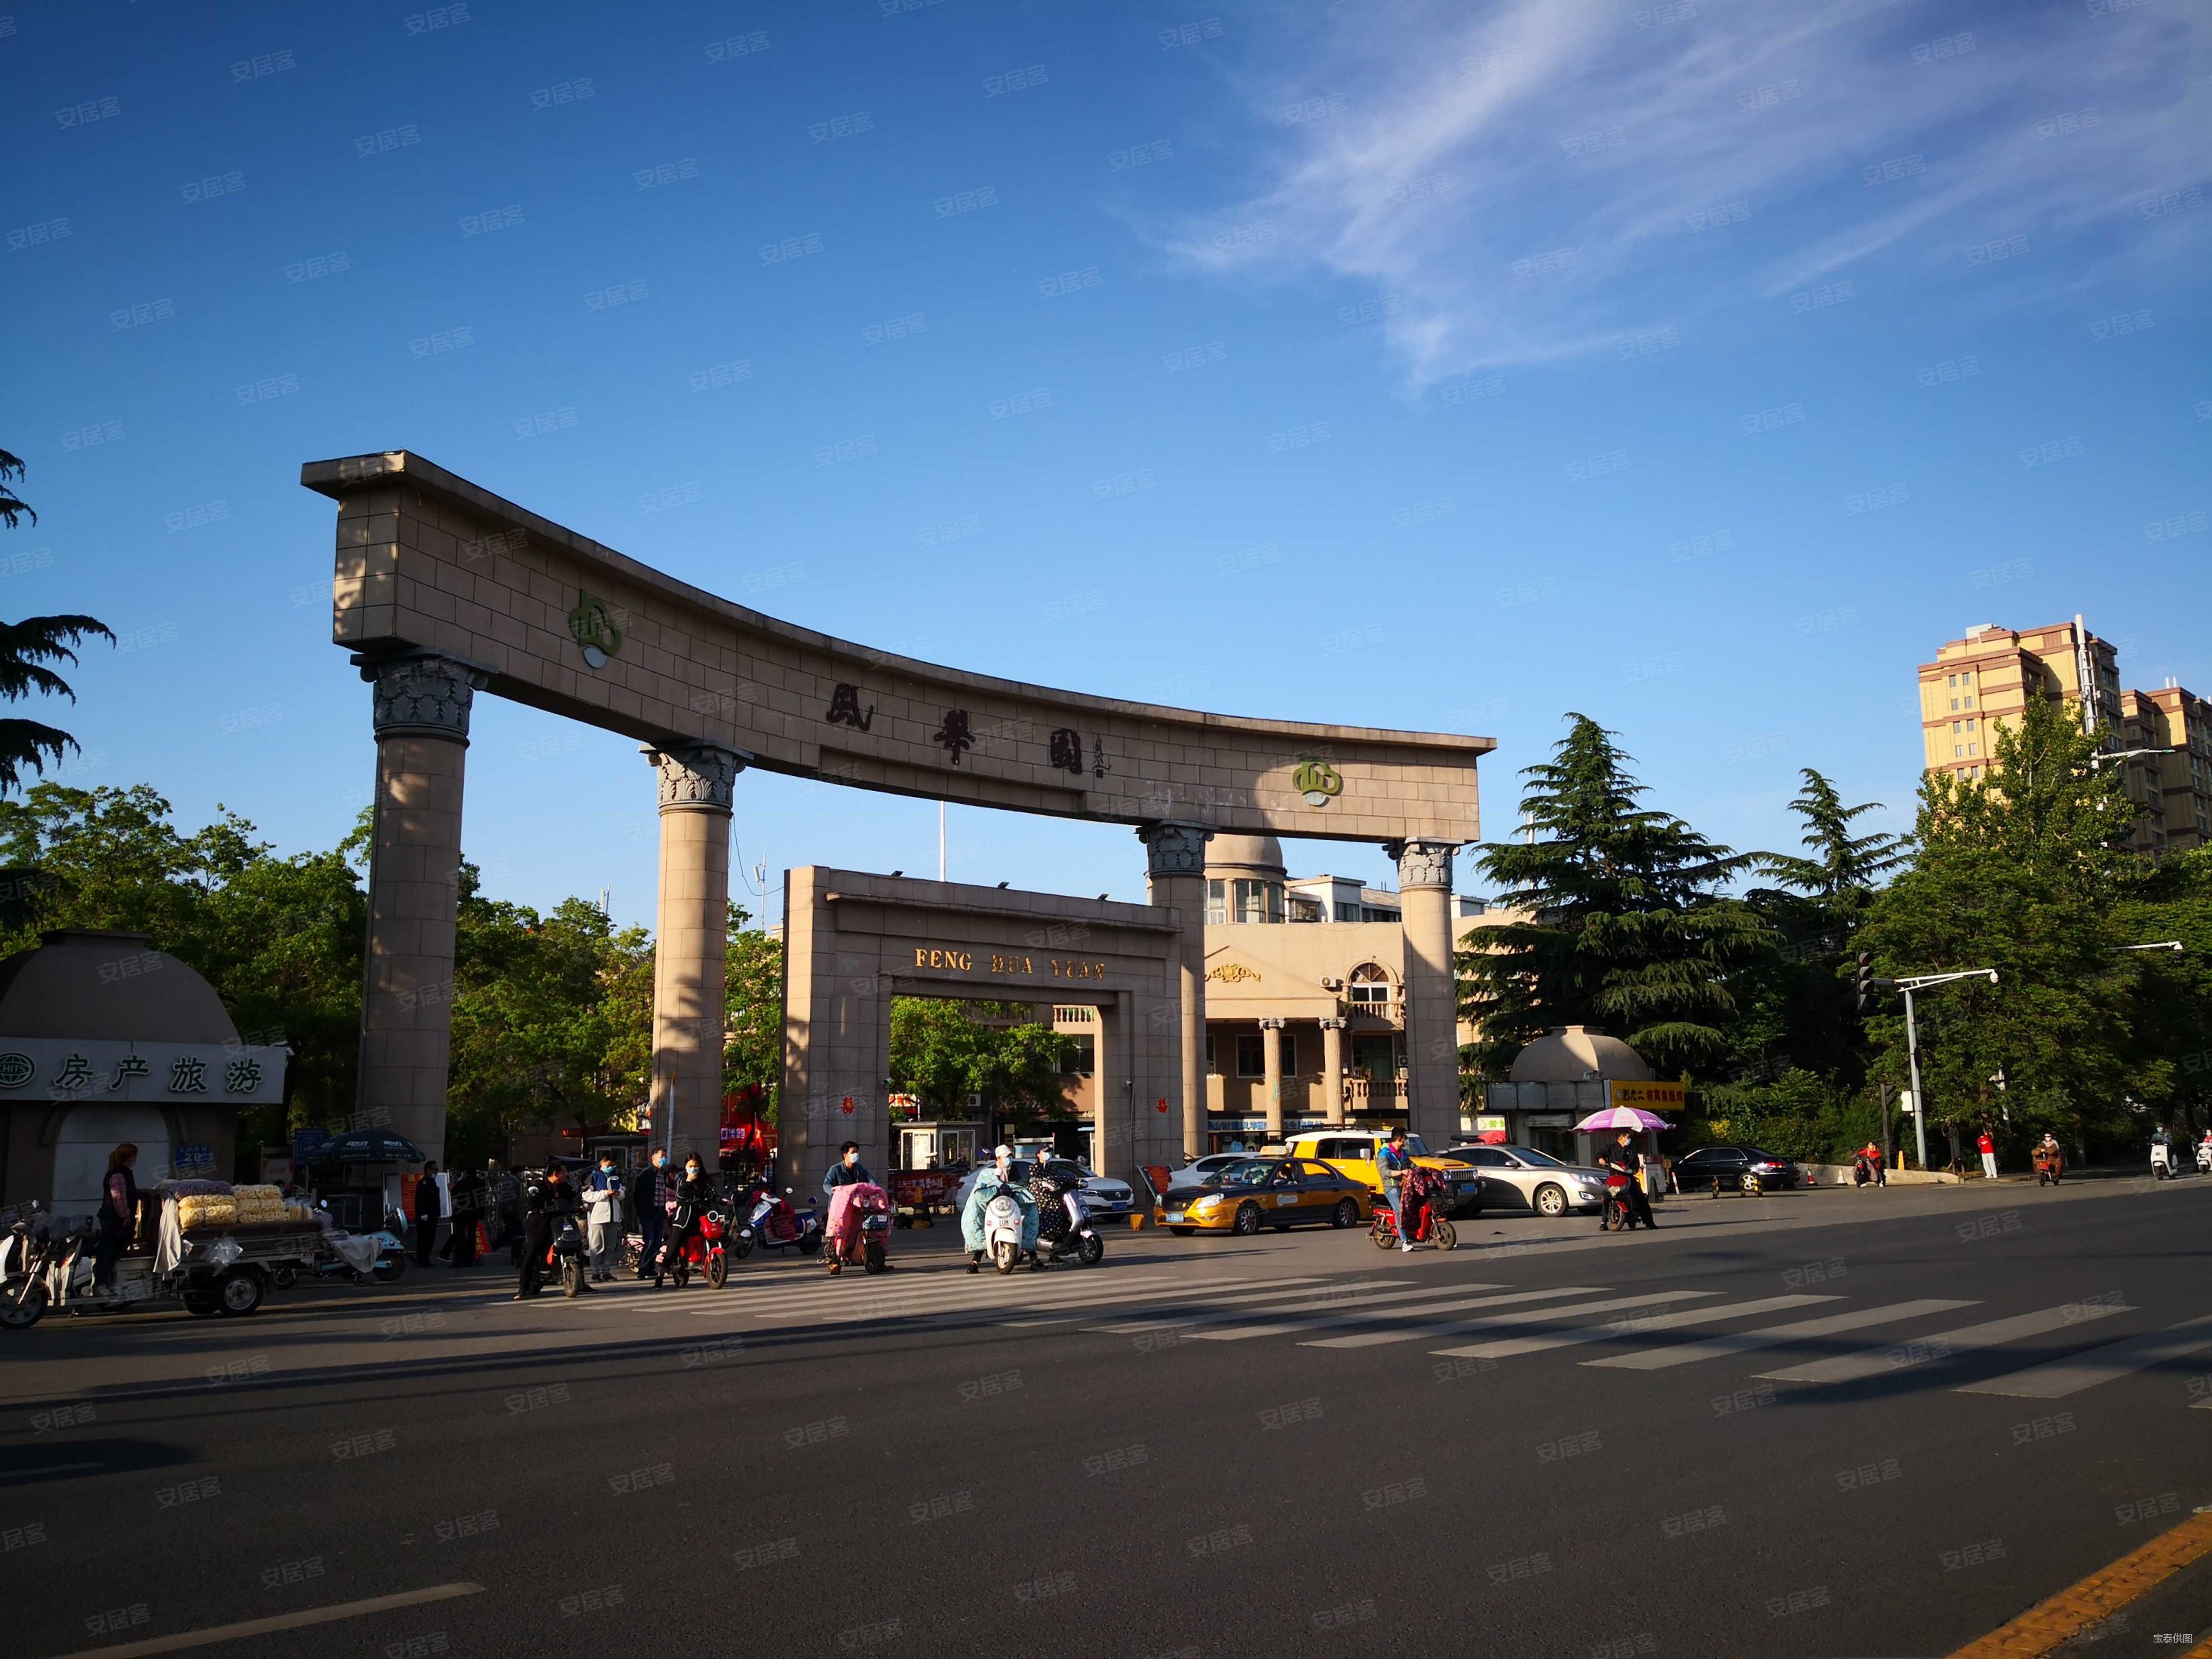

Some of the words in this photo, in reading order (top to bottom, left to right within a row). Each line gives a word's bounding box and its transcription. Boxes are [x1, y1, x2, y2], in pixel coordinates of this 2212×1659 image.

[914, 947, 973, 971] FENG
[991, 954, 1034, 974] HUA
[1051, 958, 1106, 980] YUAN
[53, 1053, 262, 1093] 房产旅游
